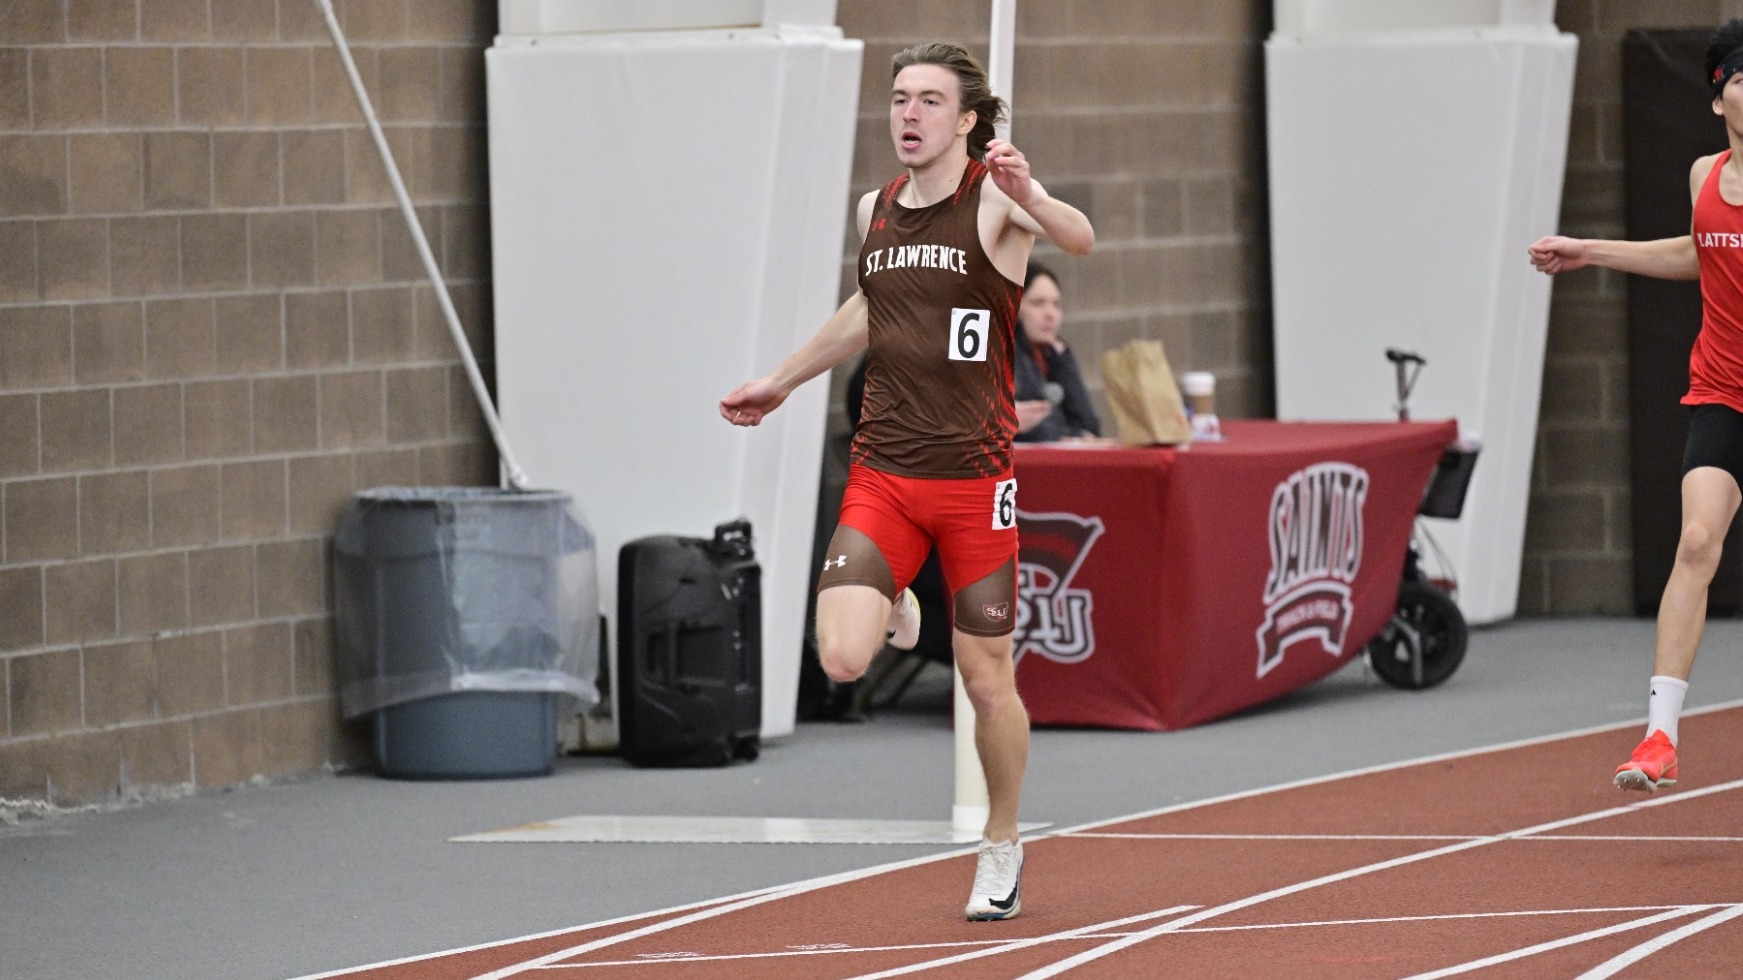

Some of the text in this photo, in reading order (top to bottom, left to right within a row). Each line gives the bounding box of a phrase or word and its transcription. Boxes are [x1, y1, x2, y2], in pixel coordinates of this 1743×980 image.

[865, 244, 968, 276] ST. LAWRENCE
[1696, 232, 1743, 248] LATTS
[957, 312, 980, 358] 6
[1000, 483, 1013, 527] 6
[1264, 462, 1369, 604] SAINTS
